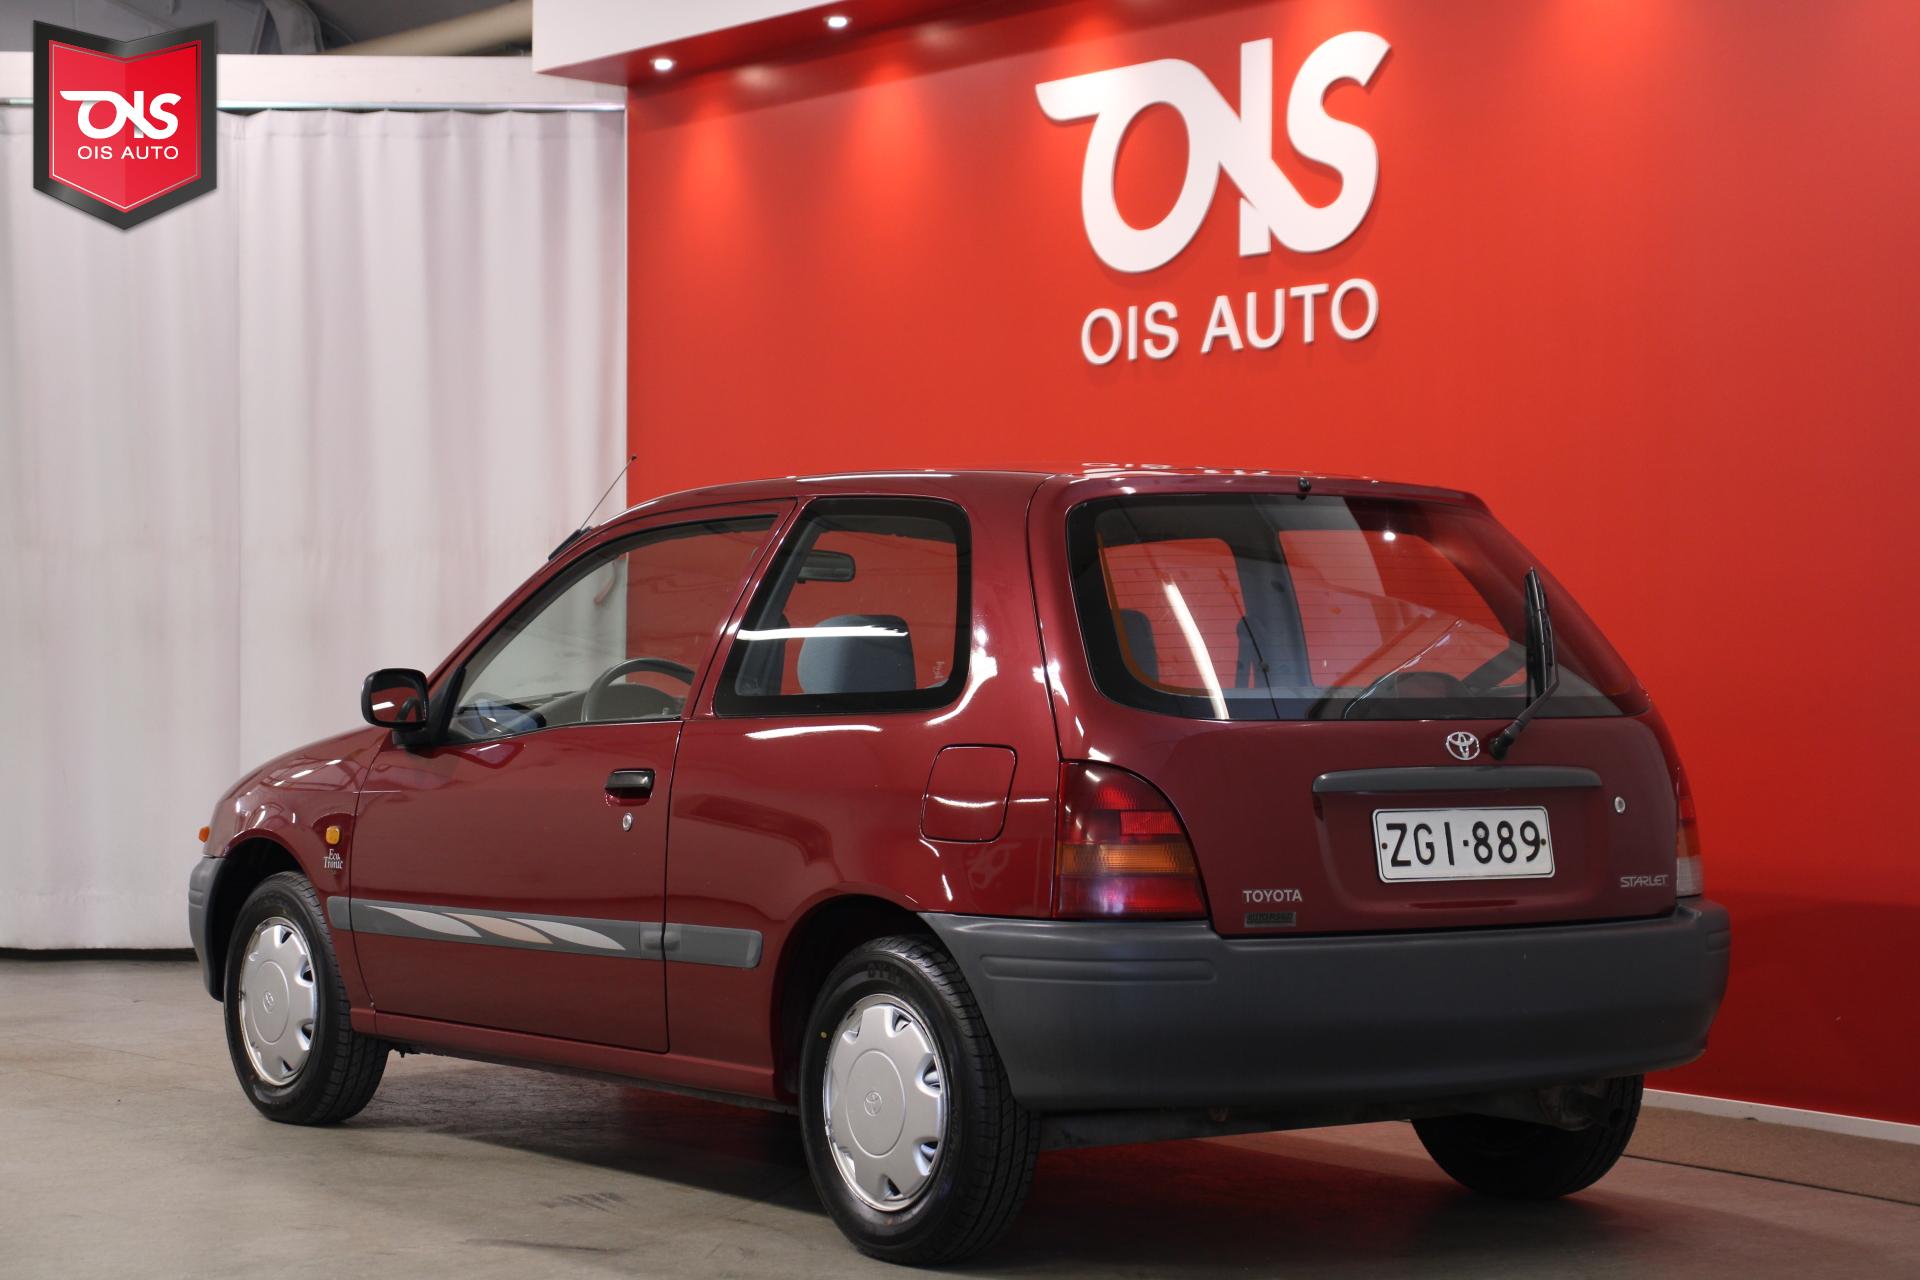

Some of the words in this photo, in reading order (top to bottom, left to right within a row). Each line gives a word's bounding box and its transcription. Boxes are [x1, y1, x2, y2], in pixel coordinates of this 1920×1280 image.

[1035, 31, 1391, 272] OIS
[1081, 301, 1179, 365] OIS
[1201, 278, 1379, 354] AUTO
[1243, 889, 1303, 903] TOYOTA
[1619, 874, 1669, 888] STARLET
